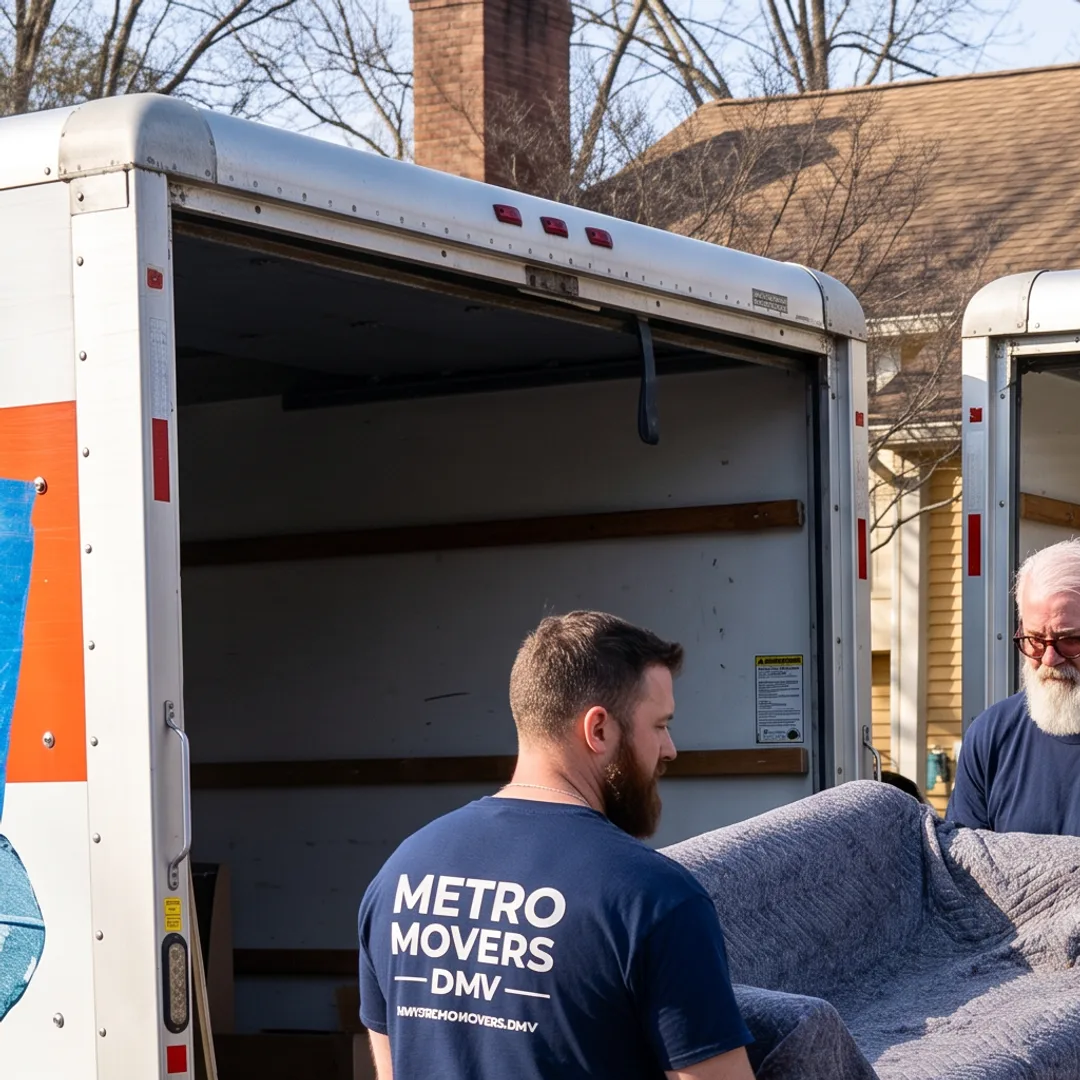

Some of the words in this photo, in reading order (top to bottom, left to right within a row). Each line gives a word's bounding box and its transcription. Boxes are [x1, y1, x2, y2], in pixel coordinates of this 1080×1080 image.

[393, 873, 566, 929] METRO
[391, 921, 555, 973] MOVERS
[430, 967, 502, 1001] DMV
